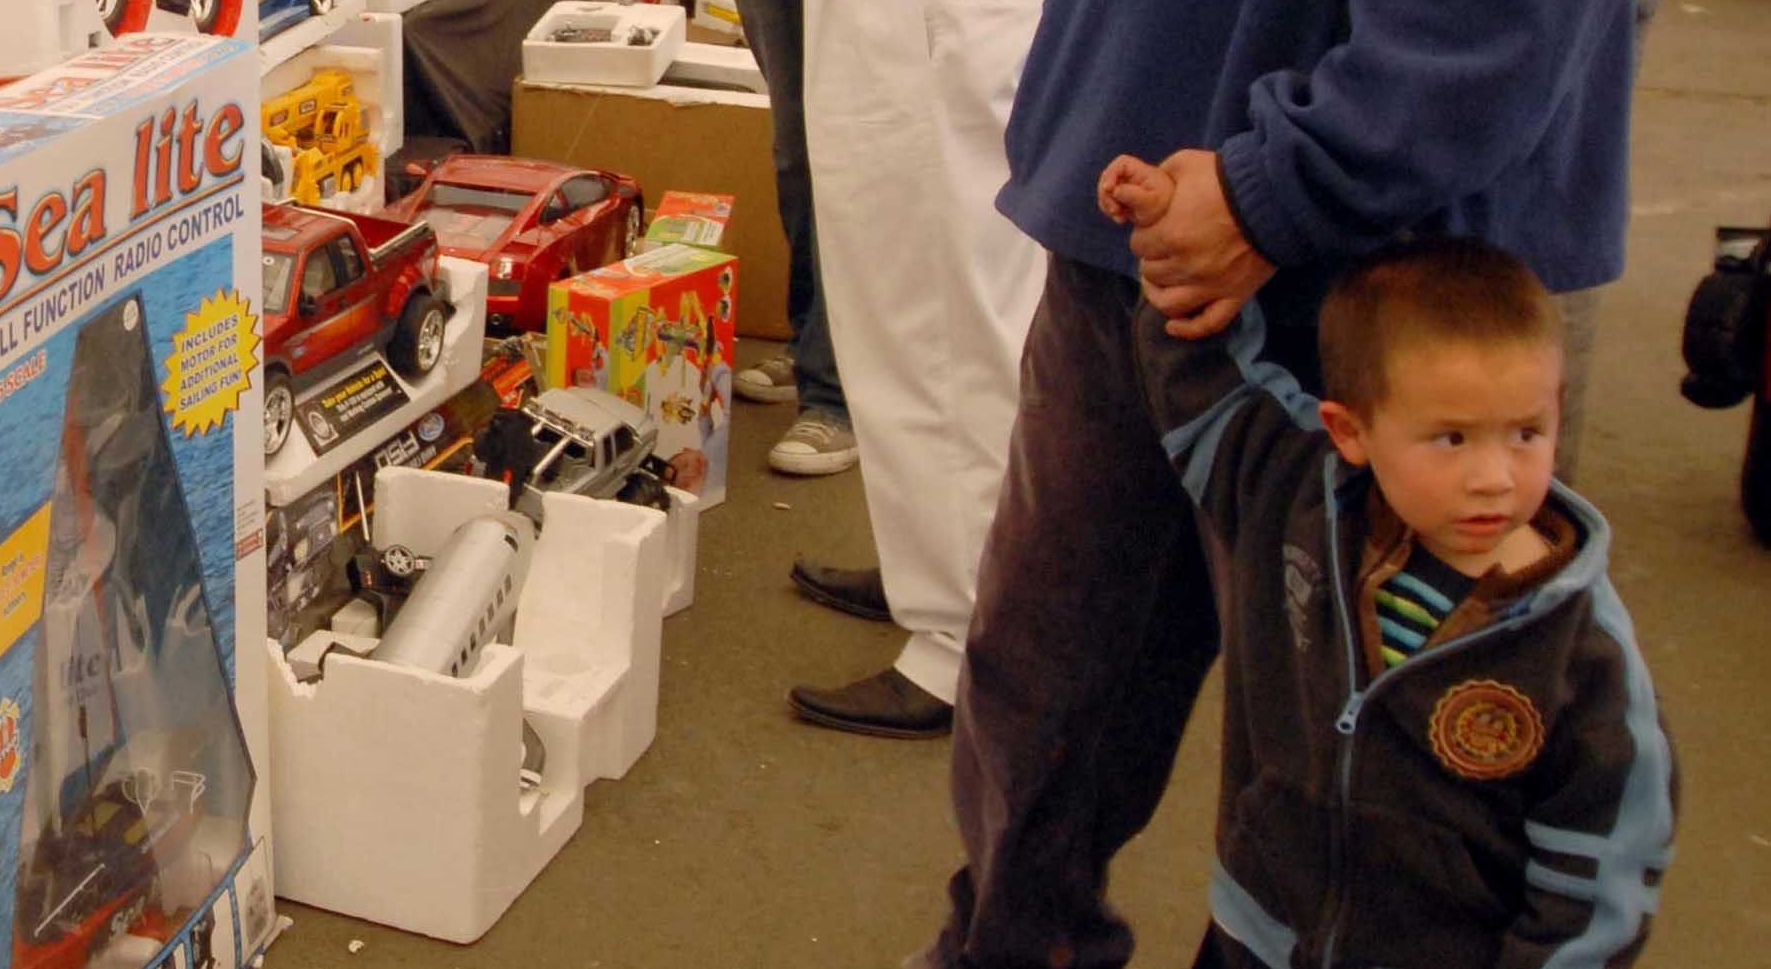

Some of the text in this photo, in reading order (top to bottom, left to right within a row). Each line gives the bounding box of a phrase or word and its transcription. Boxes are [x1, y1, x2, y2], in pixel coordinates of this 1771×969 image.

[130, 98, 245, 220] lite
[24, 265, 105, 341] FUNCTION
[114, 233, 161, 282] RADIO
[167, 193, 245, 251] CONTROL
[181, 313, 239, 353] INCLUDES
[181, 345, 215, 371] MOTOR
[181, 352, 239, 391] ADDITIONAL
[180, 383, 218, 411] SAILING
